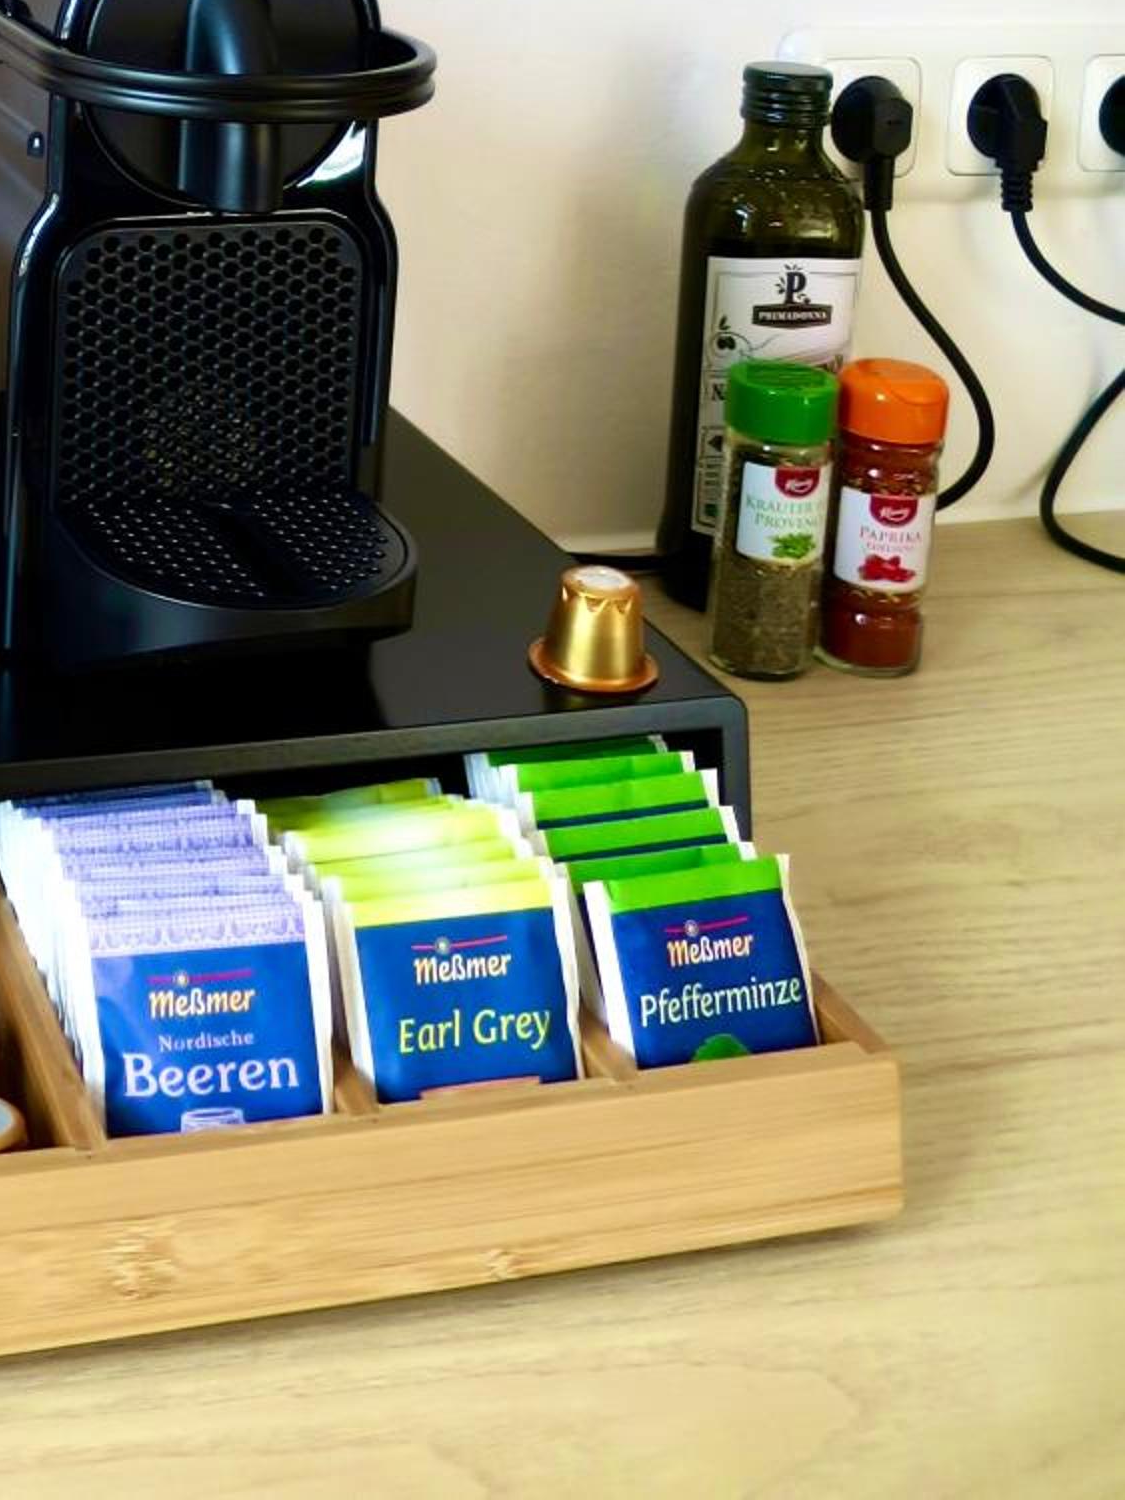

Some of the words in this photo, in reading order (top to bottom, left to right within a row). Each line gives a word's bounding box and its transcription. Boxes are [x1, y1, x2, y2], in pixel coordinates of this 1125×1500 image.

[758, 310, 828, 322] PRIMADONNA
[860, 525, 924, 543] PAPRIKA
[666, 934, 755, 968] Meßmer
[412, 952, 513, 986] Meßmer
[148, 986, 256, 1020] Meßmer
[640, 975, 803, 1028] Pfefferminze
[158, 1029, 255, 1052] Nordische
[399, 1008, 461, 1054] Earl
[473, 1008, 551, 1050] Grey
[122, 1051, 300, 1098] Beeren
